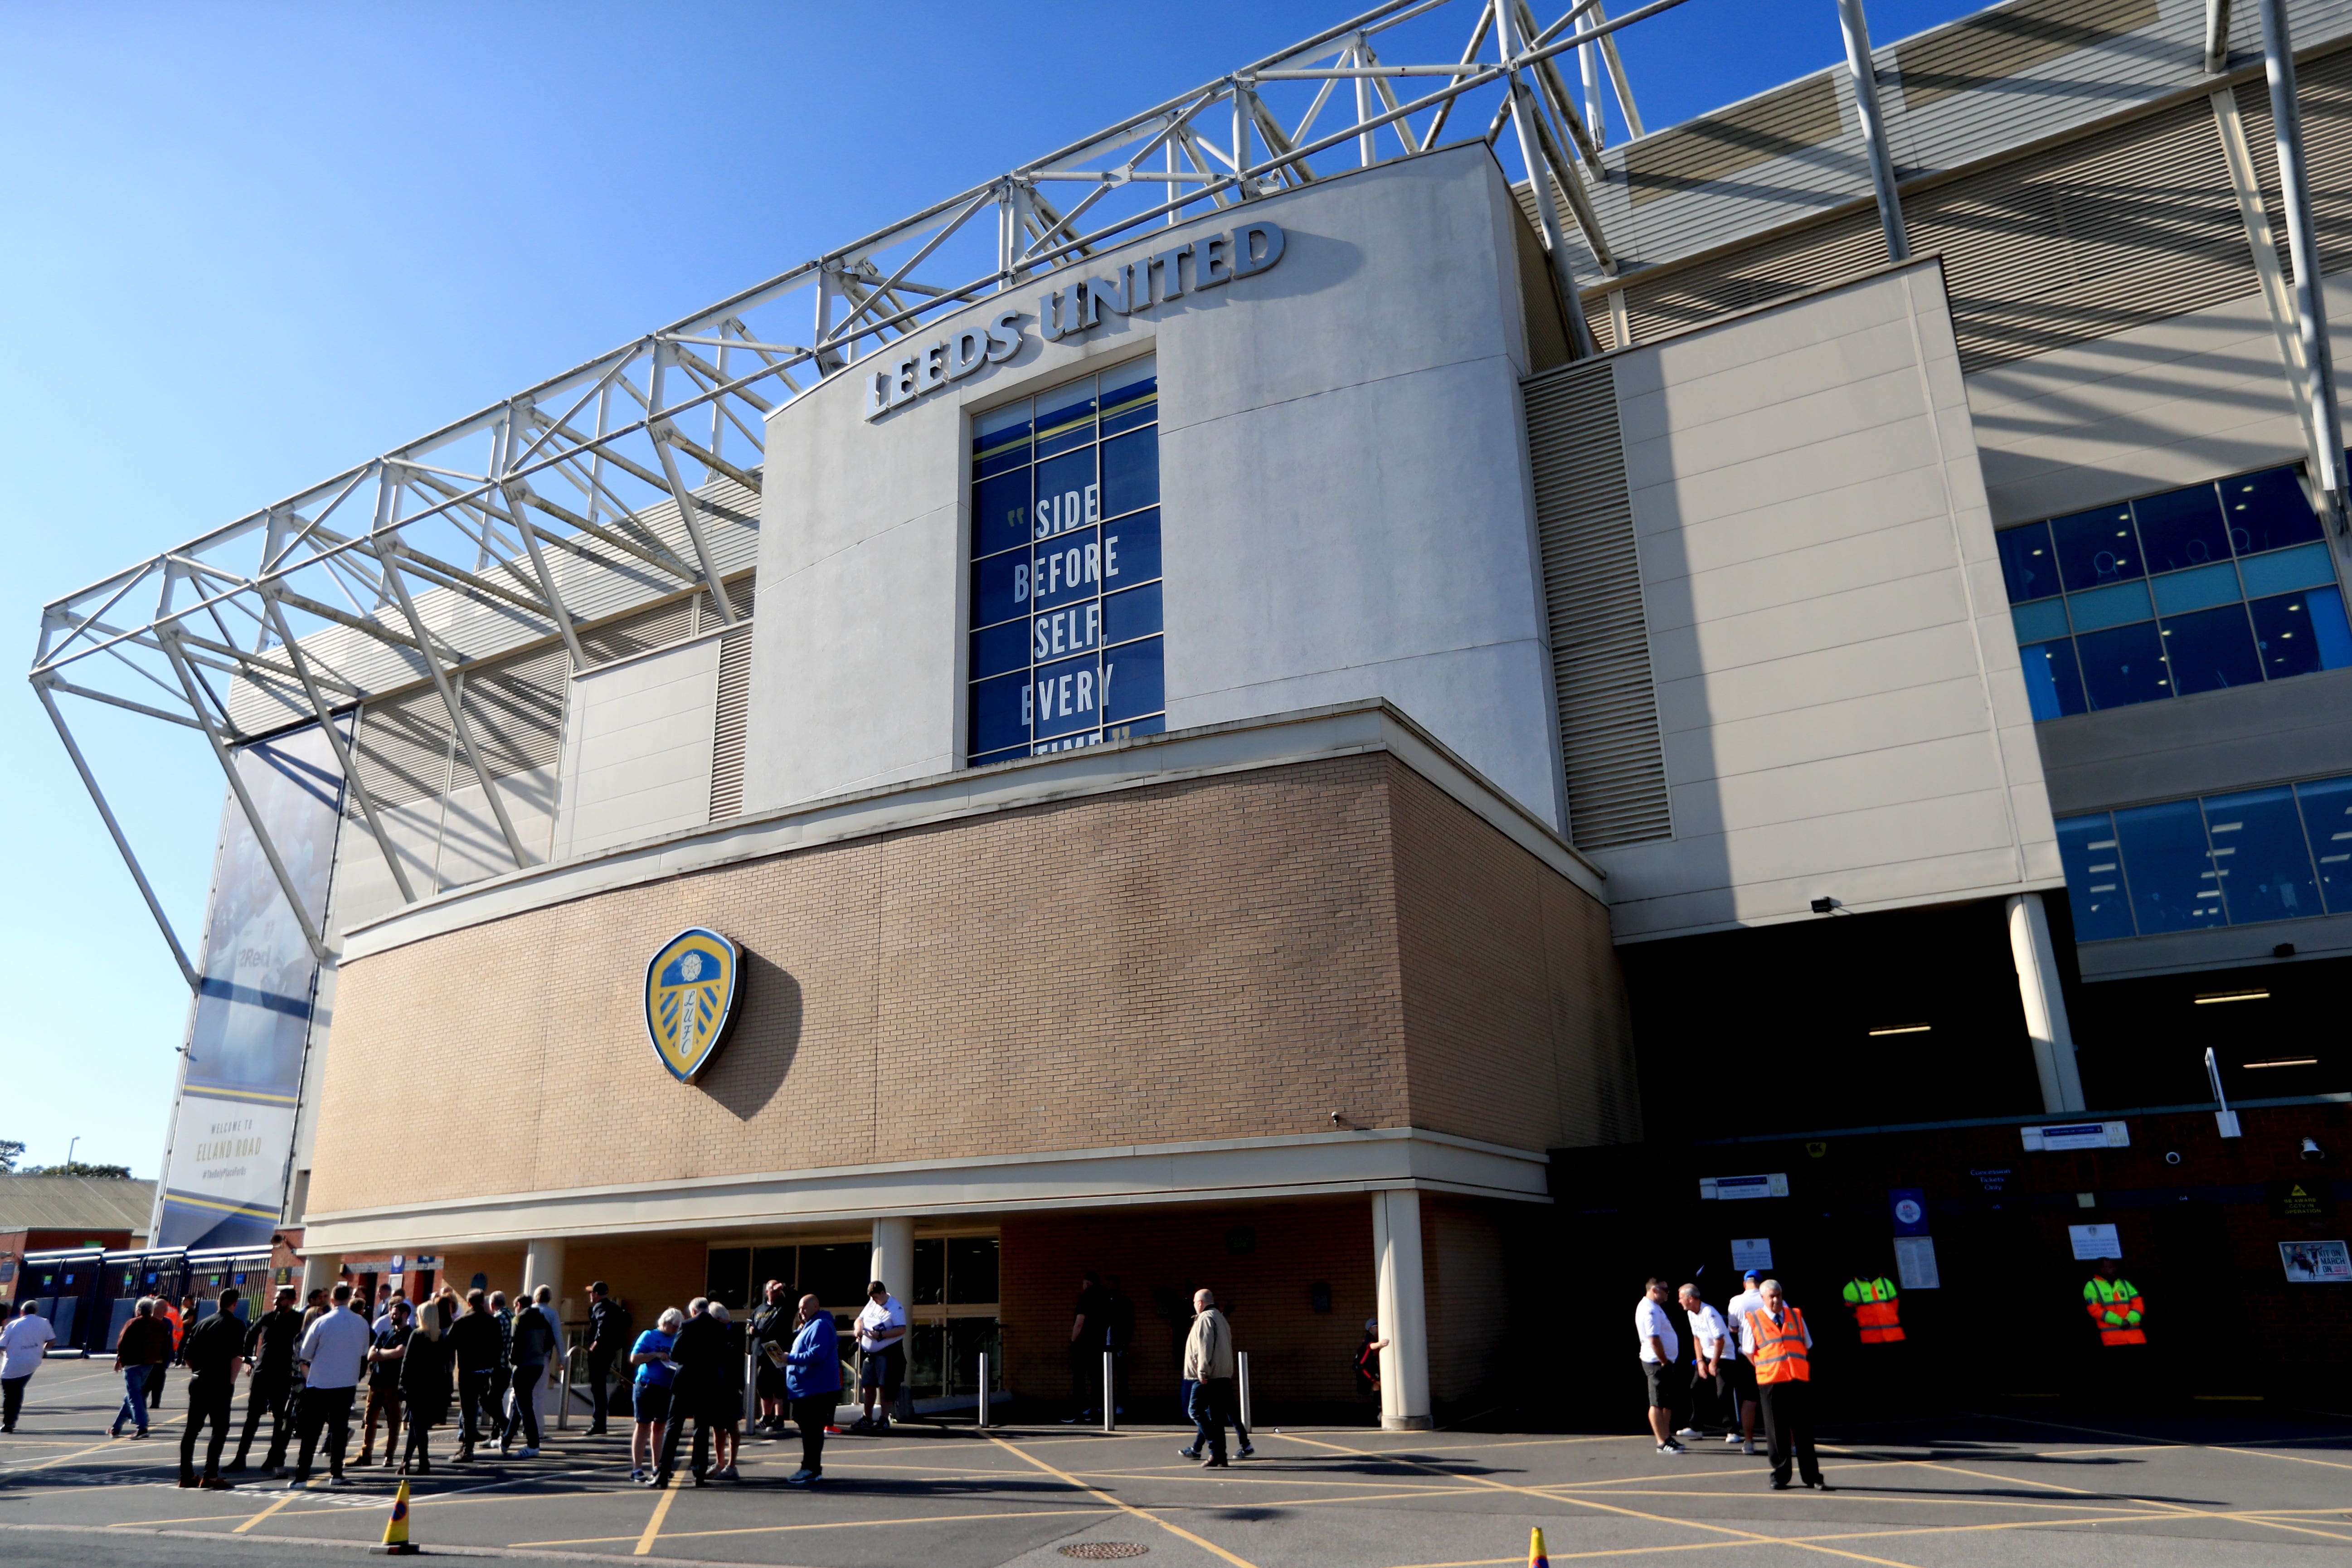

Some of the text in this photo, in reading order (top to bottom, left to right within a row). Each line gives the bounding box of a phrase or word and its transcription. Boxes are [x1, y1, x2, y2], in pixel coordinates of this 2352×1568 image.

[865, 220, 1286, 422] LEEDS UNITED
[1015, 536, 1118, 603] BEFORE
[1021, 664, 1113, 726] EVERY
[212, 1119, 253, 1134] WELCOME TO
[196, 1136, 262, 1161] ELLAND ROAD
[203, 1166, 247, 1180] #TheOnlyPlaceForUs
